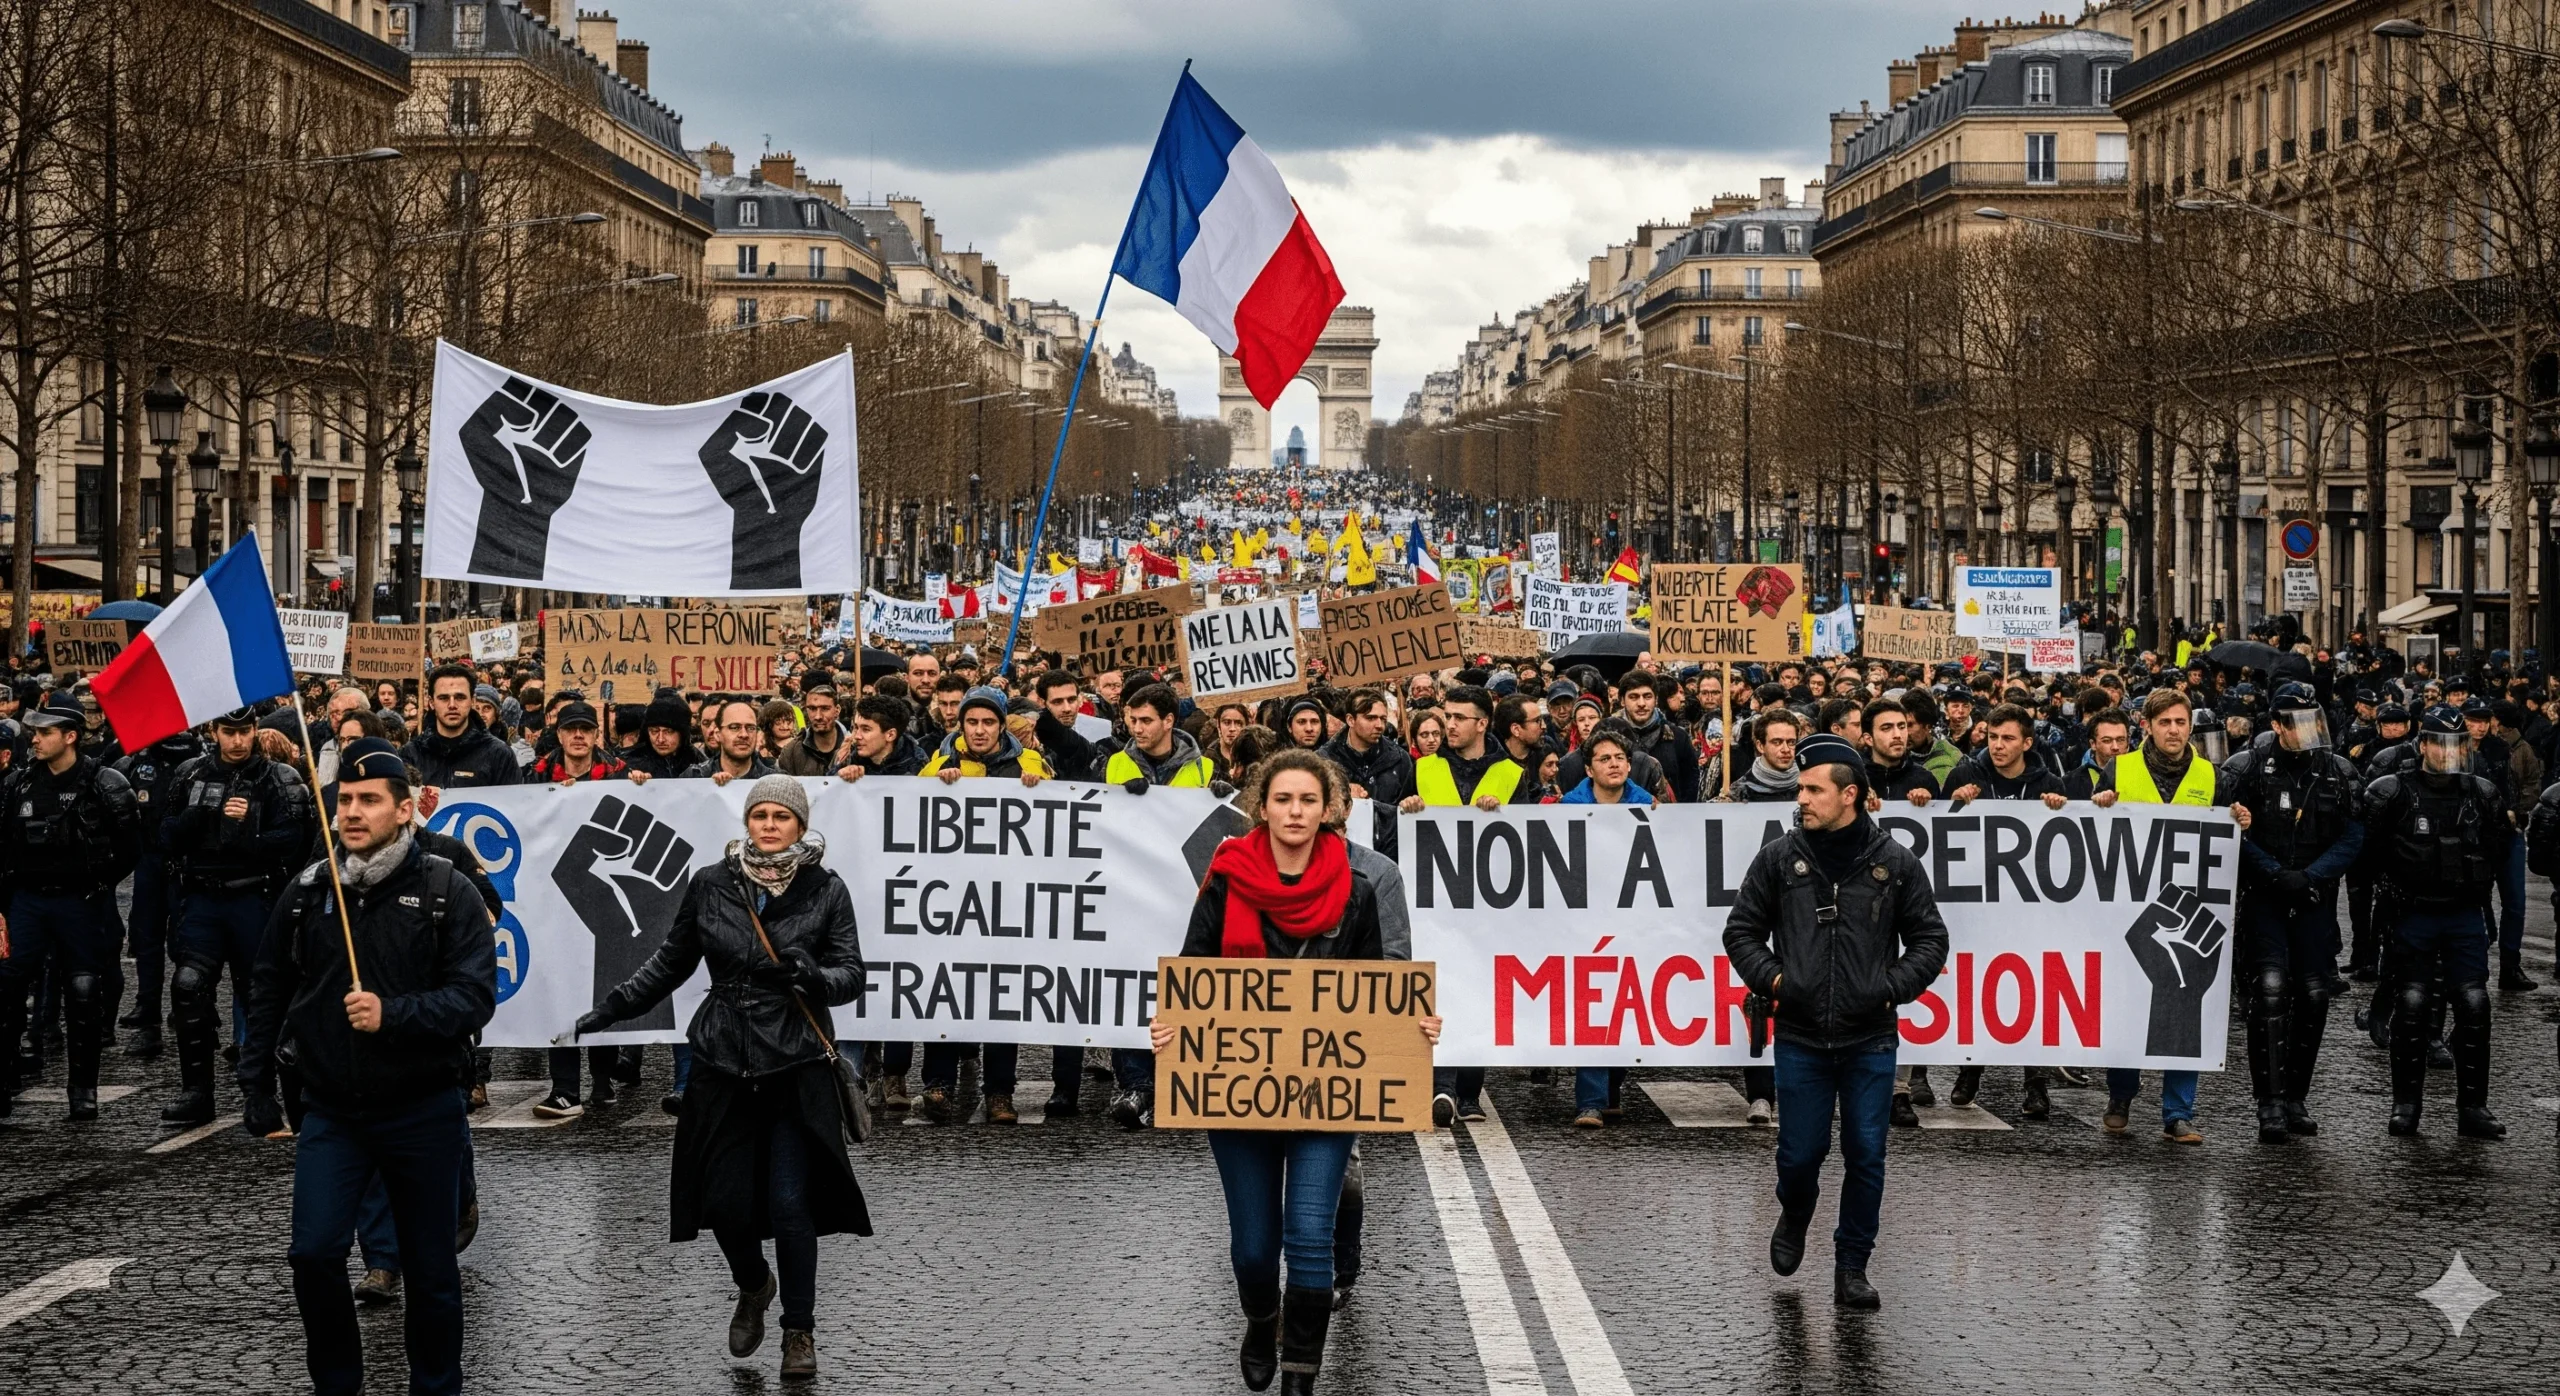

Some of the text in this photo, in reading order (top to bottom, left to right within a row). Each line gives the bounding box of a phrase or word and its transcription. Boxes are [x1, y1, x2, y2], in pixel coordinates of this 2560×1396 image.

[619, 612, 652, 643] LA
[1188, 614, 1223, 651] ME
[1225, 609, 1258, 644] LA
[1258, 606, 1289, 640] LA
[1691, 599, 1739, 623] LATE
[883, 788, 1102, 860] LIBERTÉ
[1415, 819, 1588, 909] NON
[1616, 807, 1674, 909] À
[884, 865, 1107, 942] ÉGALITÉ
[1165, 966, 1433, 1017] NOTRE FUTUR
[1179, 1017, 1367, 1069] N'EST PAS
